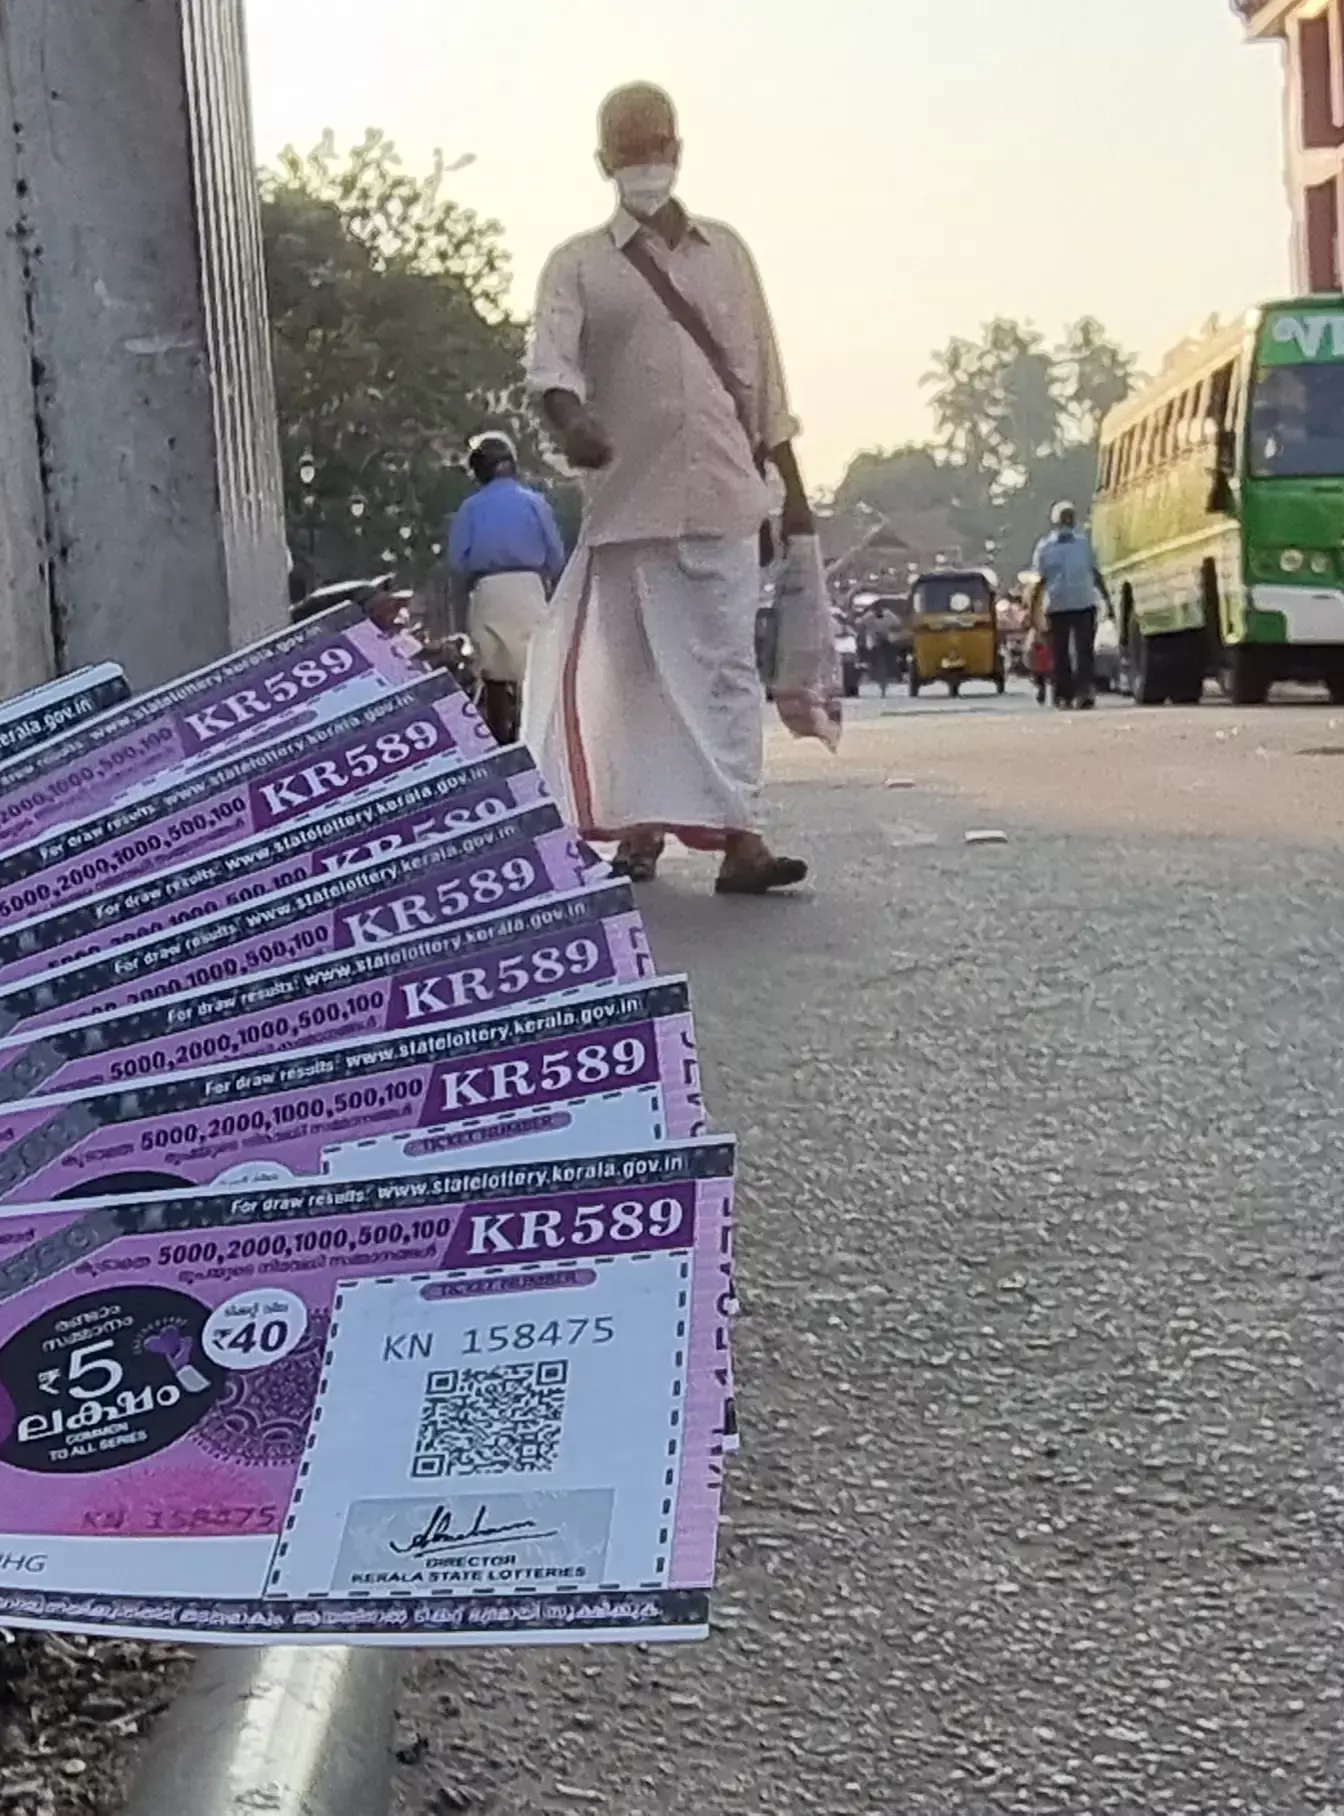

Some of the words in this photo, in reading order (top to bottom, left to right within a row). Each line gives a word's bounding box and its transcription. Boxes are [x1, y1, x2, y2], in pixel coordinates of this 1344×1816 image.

[0, 762, 36, 787] draw
[89, 624, 323, 742] www.statelottery.kerala.gov.in
[183, 646, 355, 743] KR589
[39, 839, 65, 861] For
[66, 823, 105, 848] draw
[163, 692, 415, 809] www.statelottery.kerala.gov.in
[258, 719, 441, 817] KR589
[95, 897, 121, 921] For
[123, 884, 163, 914] draw
[223, 765, 489, 870] www.statelottery.kerala.gov.in
[113, 952, 139, 974] For
[143, 939, 181, 966] draw
[244, 823, 516, 928] www.statelottery.kerala.gov.in
[343, 855, 538, 950] KR589
[167, 1000, 193, 1023] For
[196, 991, 236, 1016] draw
[302, 902, 587, 988] www.statelottery.kerala.gov.in
[399, 937, 600, 1020] KR589
[109, 988, 385, 1081] 5000,2000,1000,500,100
[205, 1079, 232, 1097] For
[235, 1070, 276, 1092] draw
[344, 997, 640, 1069] www.statelottery.kerala.gov.in
[440, 1036, 646, 1112] KR589
[140, 1077, 424, 1151] 5000,2000,1000,500,100
[230, 1198, 260, 1214] For
[261, 1193, 304, 1211] draw
[376, 1154, 683, 1200] www.statelottery.kerala.gov.in
[157, 1217, 451, 1266] 5000,2000,1000,500,100
[466, 1198, 684, 1256] KR589
[37, 1339, 124, 1400] ₹5
[212, 1318, 289, 1354] ₹40
[382, 1333, 434, 1362] KN
[462, 1316, 615, 1356] 158475
[17, 1384, 181, 1443] ലക്ഷം
[49, 1449, 68, 1462] TO
[70, 1442, 97, 1458] ALL
[99, 1431, 148, 1451] SERIES
[65, 1421, 129, 1445] COMMON
[351, 1571, 424, 1584] KERALA
[429, 1571, 483, 1582] STATE
[486, 1566, 587, 1580] LOTTERIES
[425, 1554, 518, 1569] DIRECTOR
